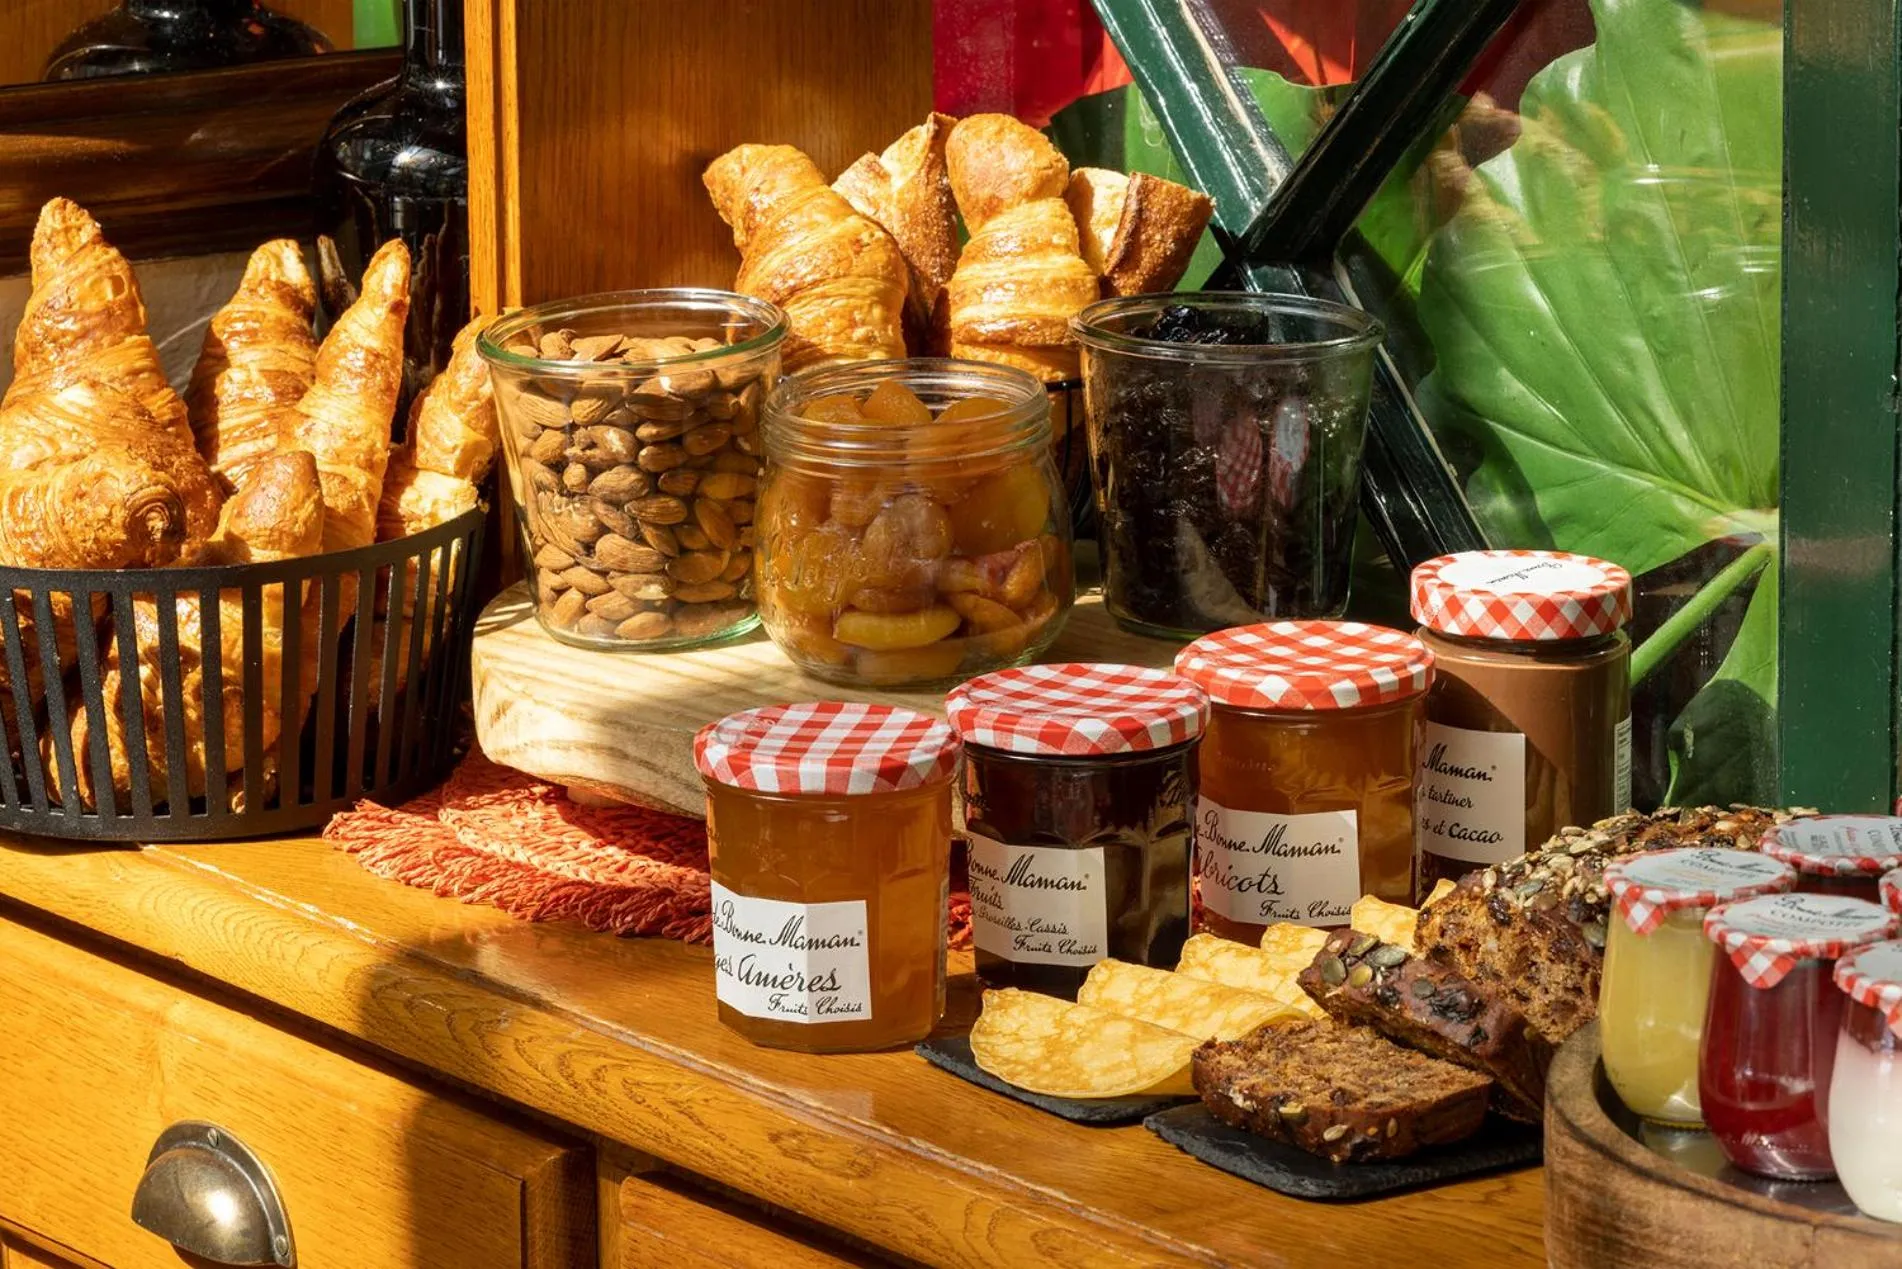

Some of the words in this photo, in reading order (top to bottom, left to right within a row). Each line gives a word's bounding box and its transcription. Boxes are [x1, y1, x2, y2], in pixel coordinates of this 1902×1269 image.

[1422, 742, 1492, 781] Maman
[1428, 785, 1474, 808] tartiner
[1204, 810, 1249, 852] Bonne
[1252, 823, 1341, 858] Maman
[1433, 820, 1445, 836] et
[1448, 822, 1503, 844] Cacao
[1001, 854, 1087, 890] Maman
[1259, 900, 1300, 919] Fruits
[722, 900, 766, 944] Bonne
[769, 914, 861, 950] Maman
[1013, 934, 1052, 953] Fruits
[1058, 939, 1097, 955] Choisis
[767, 993, 808, 1016] Fruits
[816, 996, 862, 1015] Choisis
